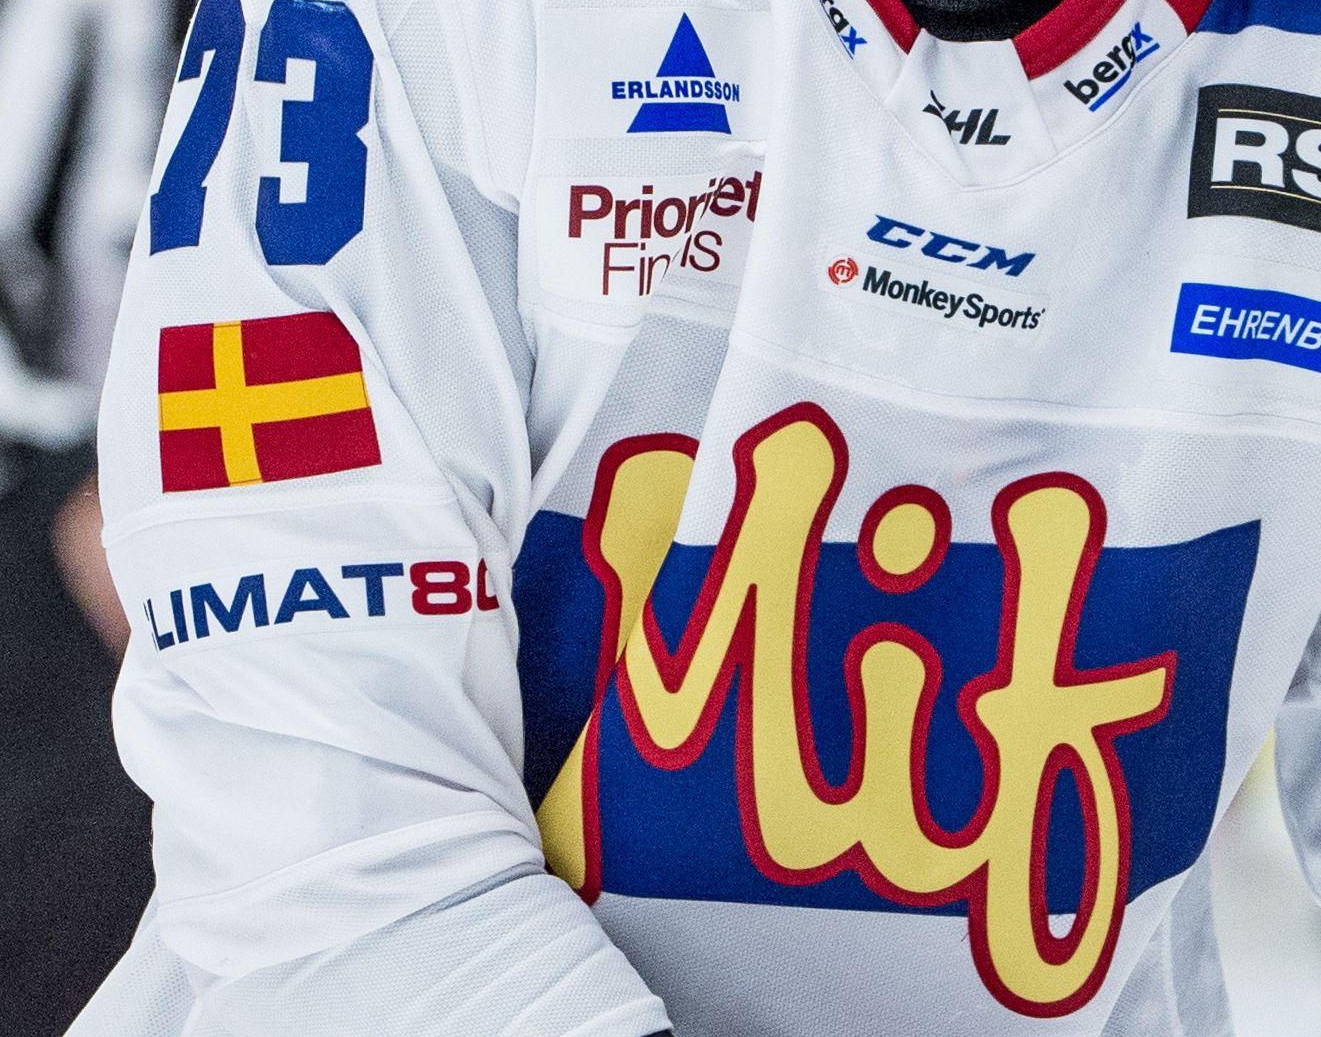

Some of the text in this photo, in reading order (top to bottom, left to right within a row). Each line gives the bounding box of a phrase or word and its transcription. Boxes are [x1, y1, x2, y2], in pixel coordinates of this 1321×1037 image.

[611, 79, 741, 103] ERLANDSSON
[866, 214, 1037, 277] CCM
[143, 557, 500, 652] LIMAT8
